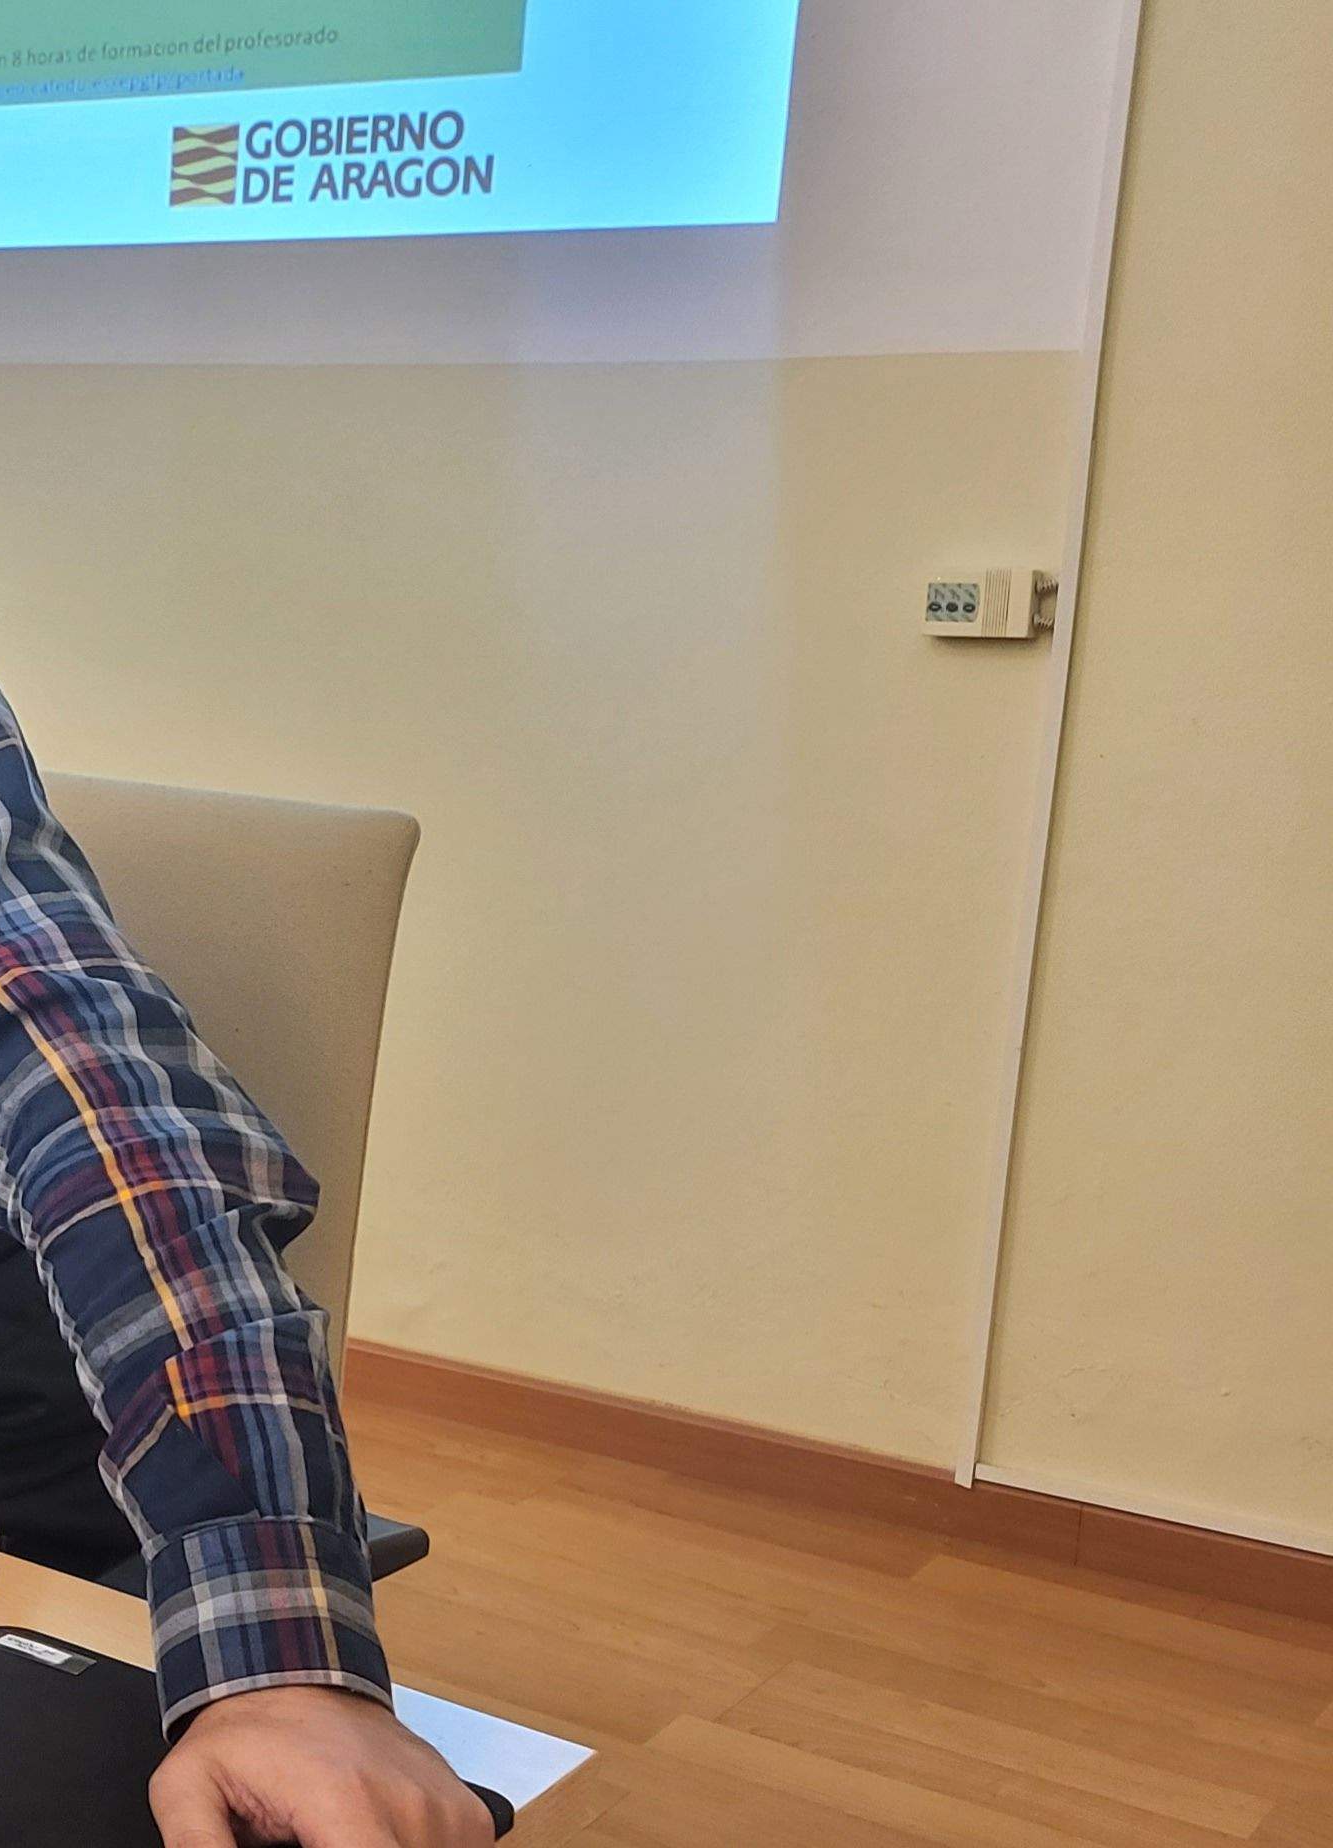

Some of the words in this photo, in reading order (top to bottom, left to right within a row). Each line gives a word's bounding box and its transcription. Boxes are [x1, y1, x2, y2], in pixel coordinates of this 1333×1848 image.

[12, 51, 23, 67] 8
[27, 47, 73, 66] horas
[77, 45, 97, 62] de
[193, 34, 222, 54] del
[224, 25, 339, 54] profesorado
[245, 110, 465, 160] GOBIERNO
[242, 165, 295, 205] DE
[309, 155, 495, 202] ARAGON
